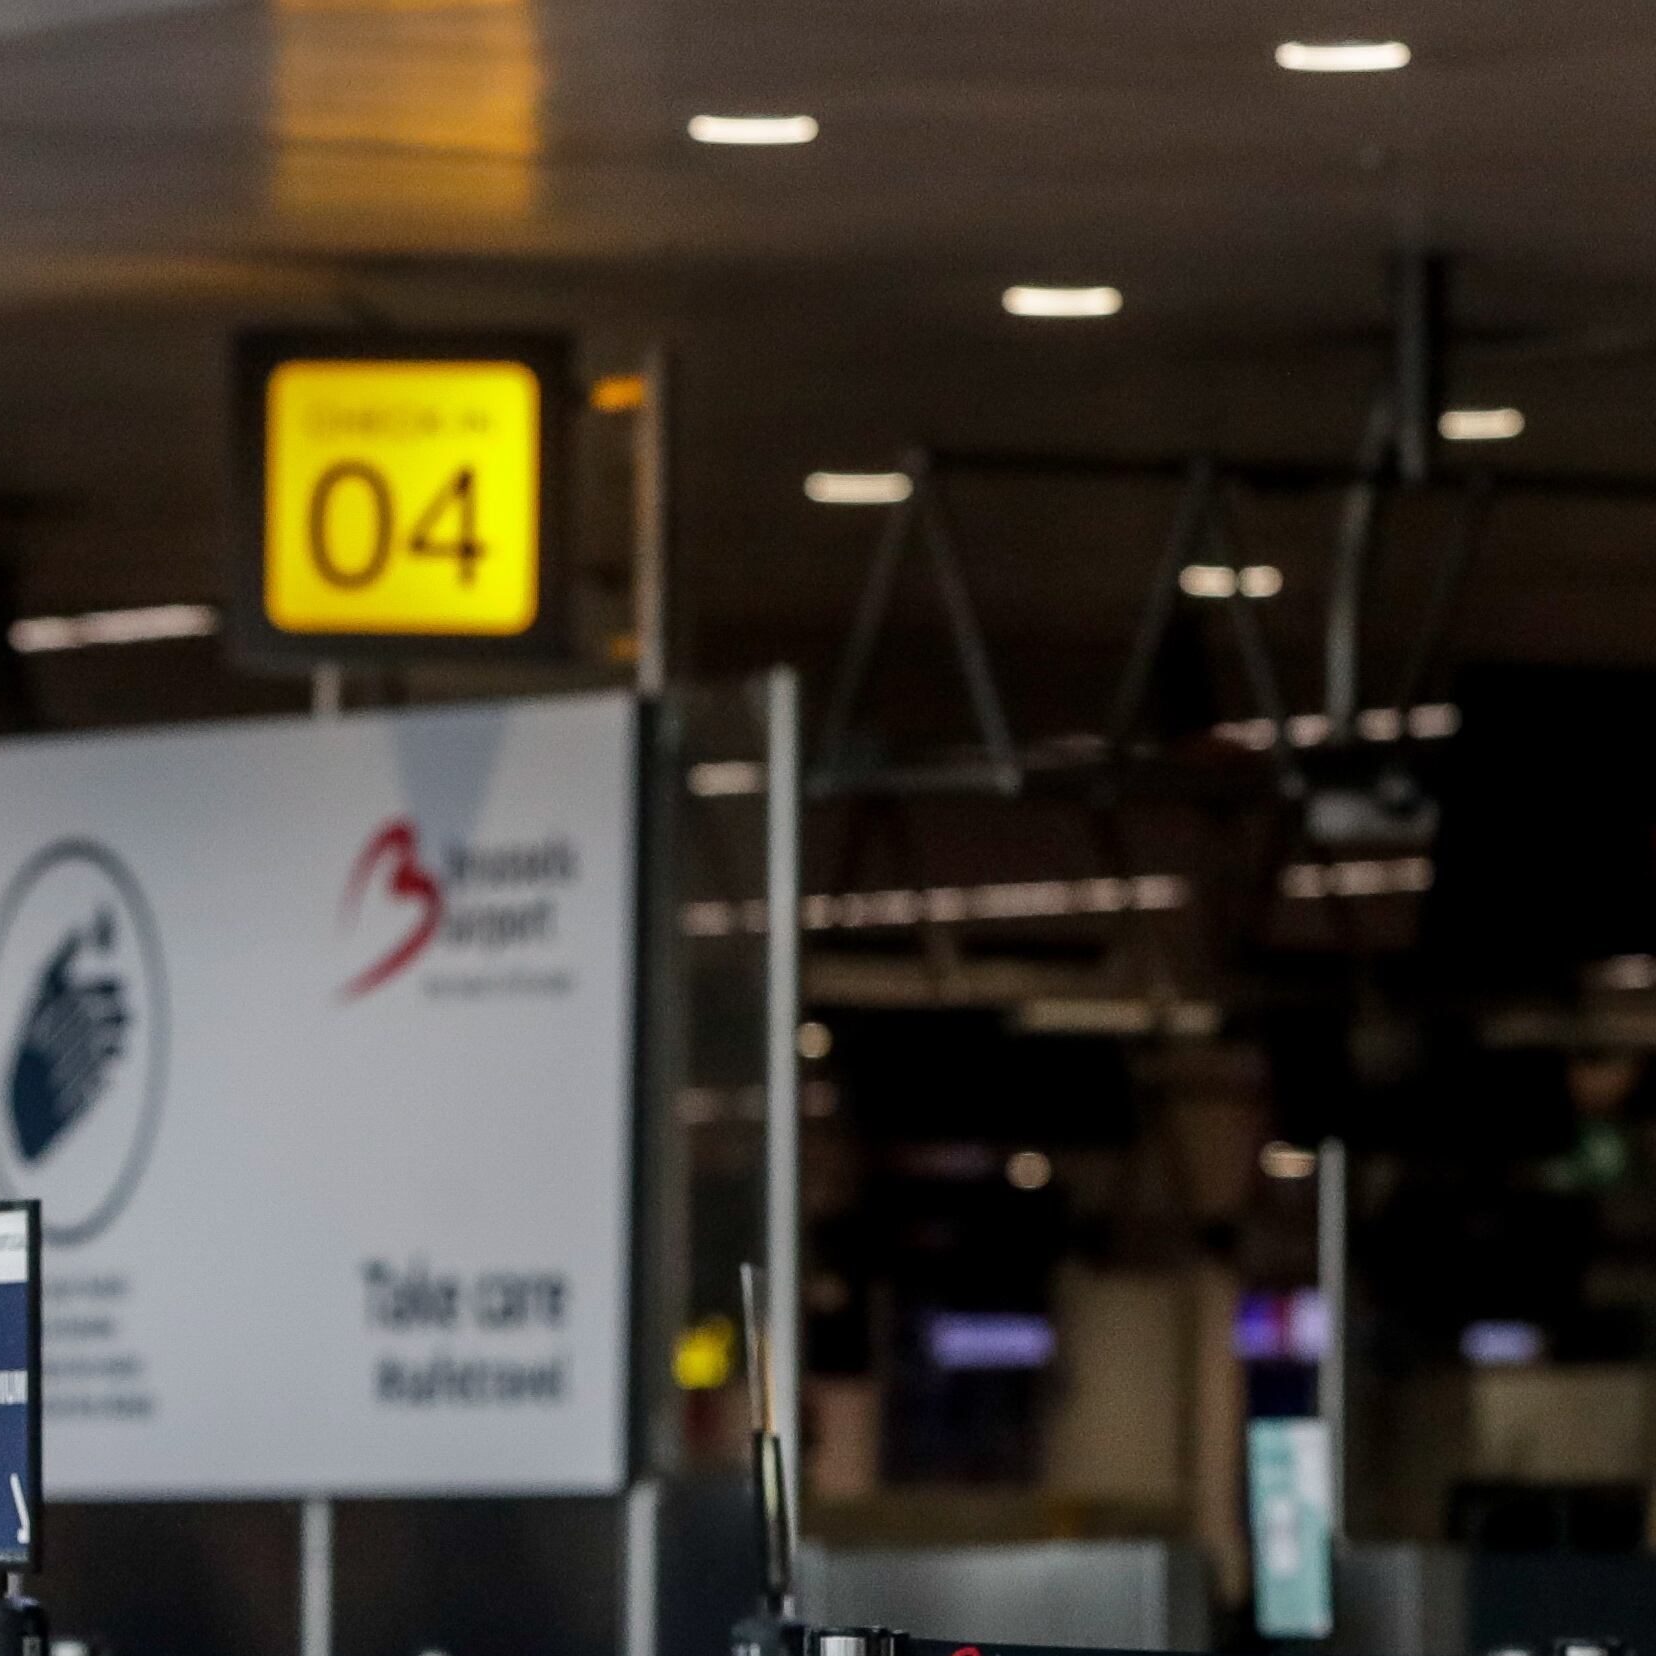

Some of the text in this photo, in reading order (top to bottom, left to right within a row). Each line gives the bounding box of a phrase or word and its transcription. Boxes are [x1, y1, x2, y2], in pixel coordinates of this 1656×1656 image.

[306, 456, 492, 590] 04
[361, 1257, 565, 1330] Take care
